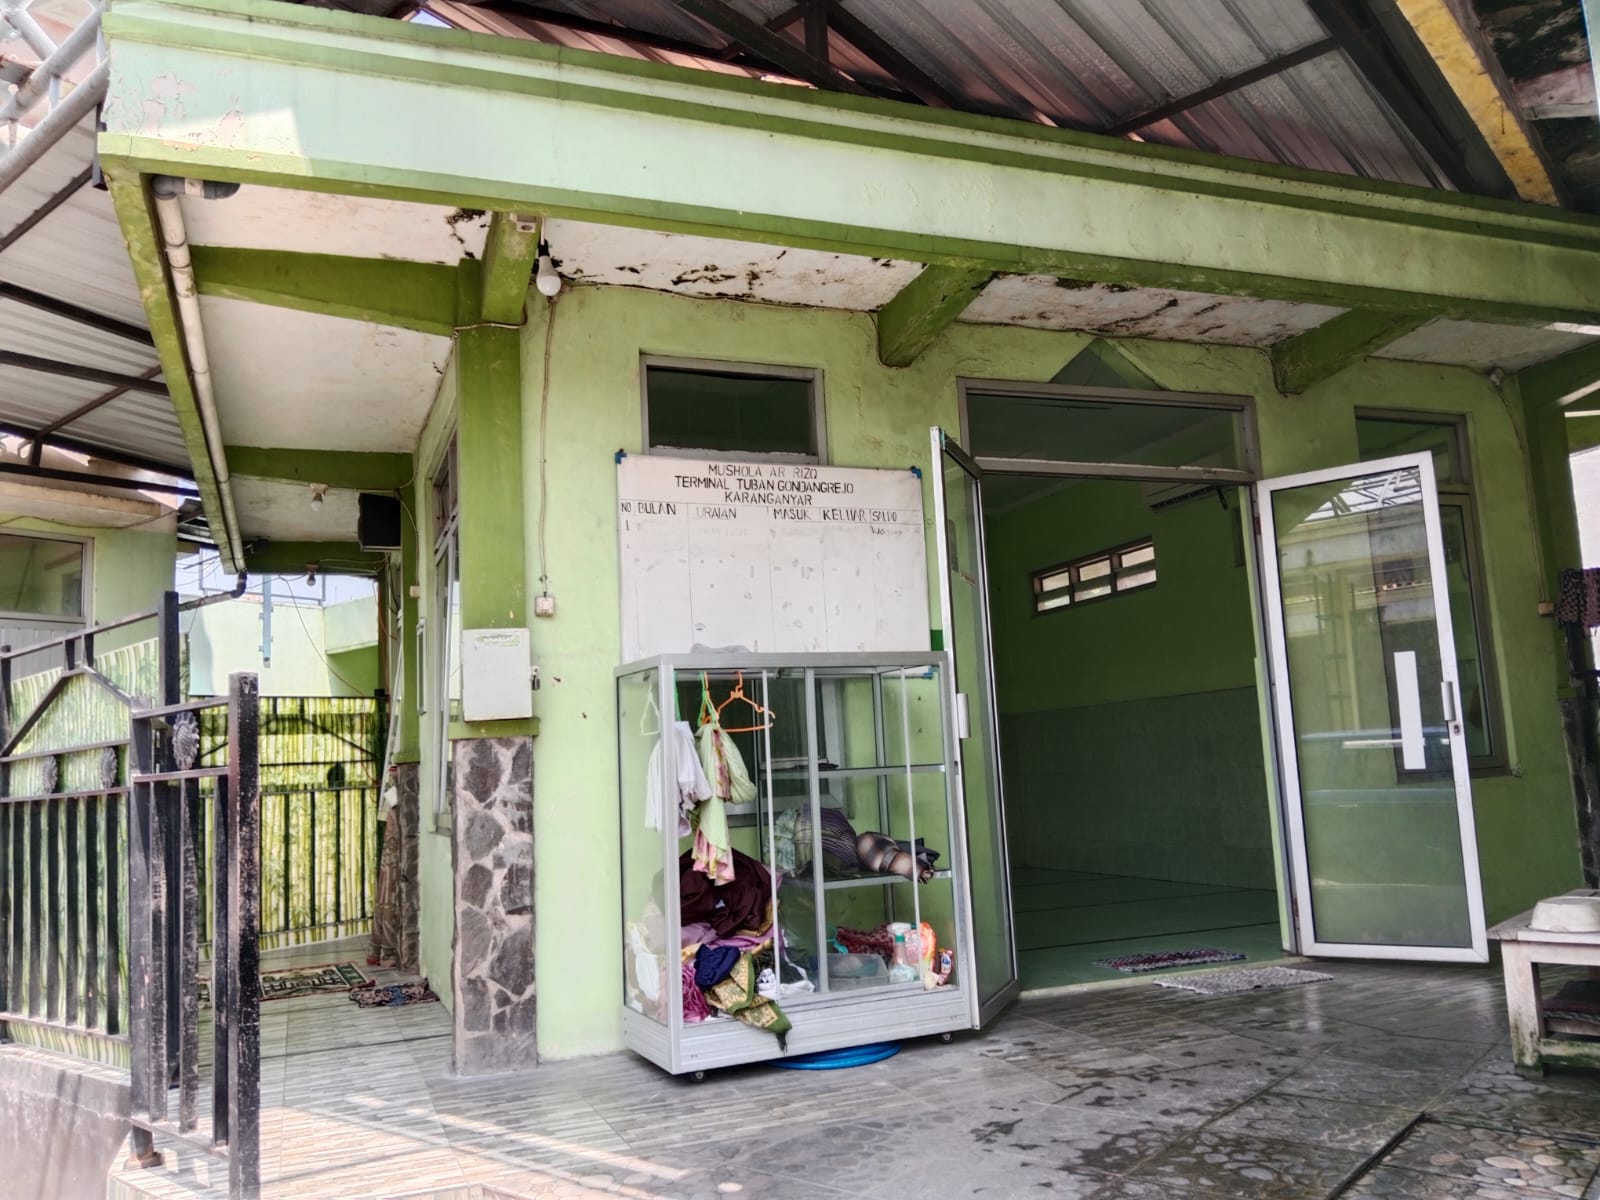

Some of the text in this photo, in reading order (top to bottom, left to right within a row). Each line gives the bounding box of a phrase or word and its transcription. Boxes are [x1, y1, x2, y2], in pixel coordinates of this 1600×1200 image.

[708, 464, 762, 477] MUSHOLA
[769, 466, 786, 478] AR
[674, 475, 854, 494] TERMINAL TUBAN GONDANGREJO
[724, 491, 813, 506] KARANGANYAR
[621, 502, 632, 513] NO
[638, 502, 677, 515] BULAN
[696, 506, 737, 519] URAIAN
[773, 508, 812, 521] MASUK
[823, 508, 867, 522] KELUAR
